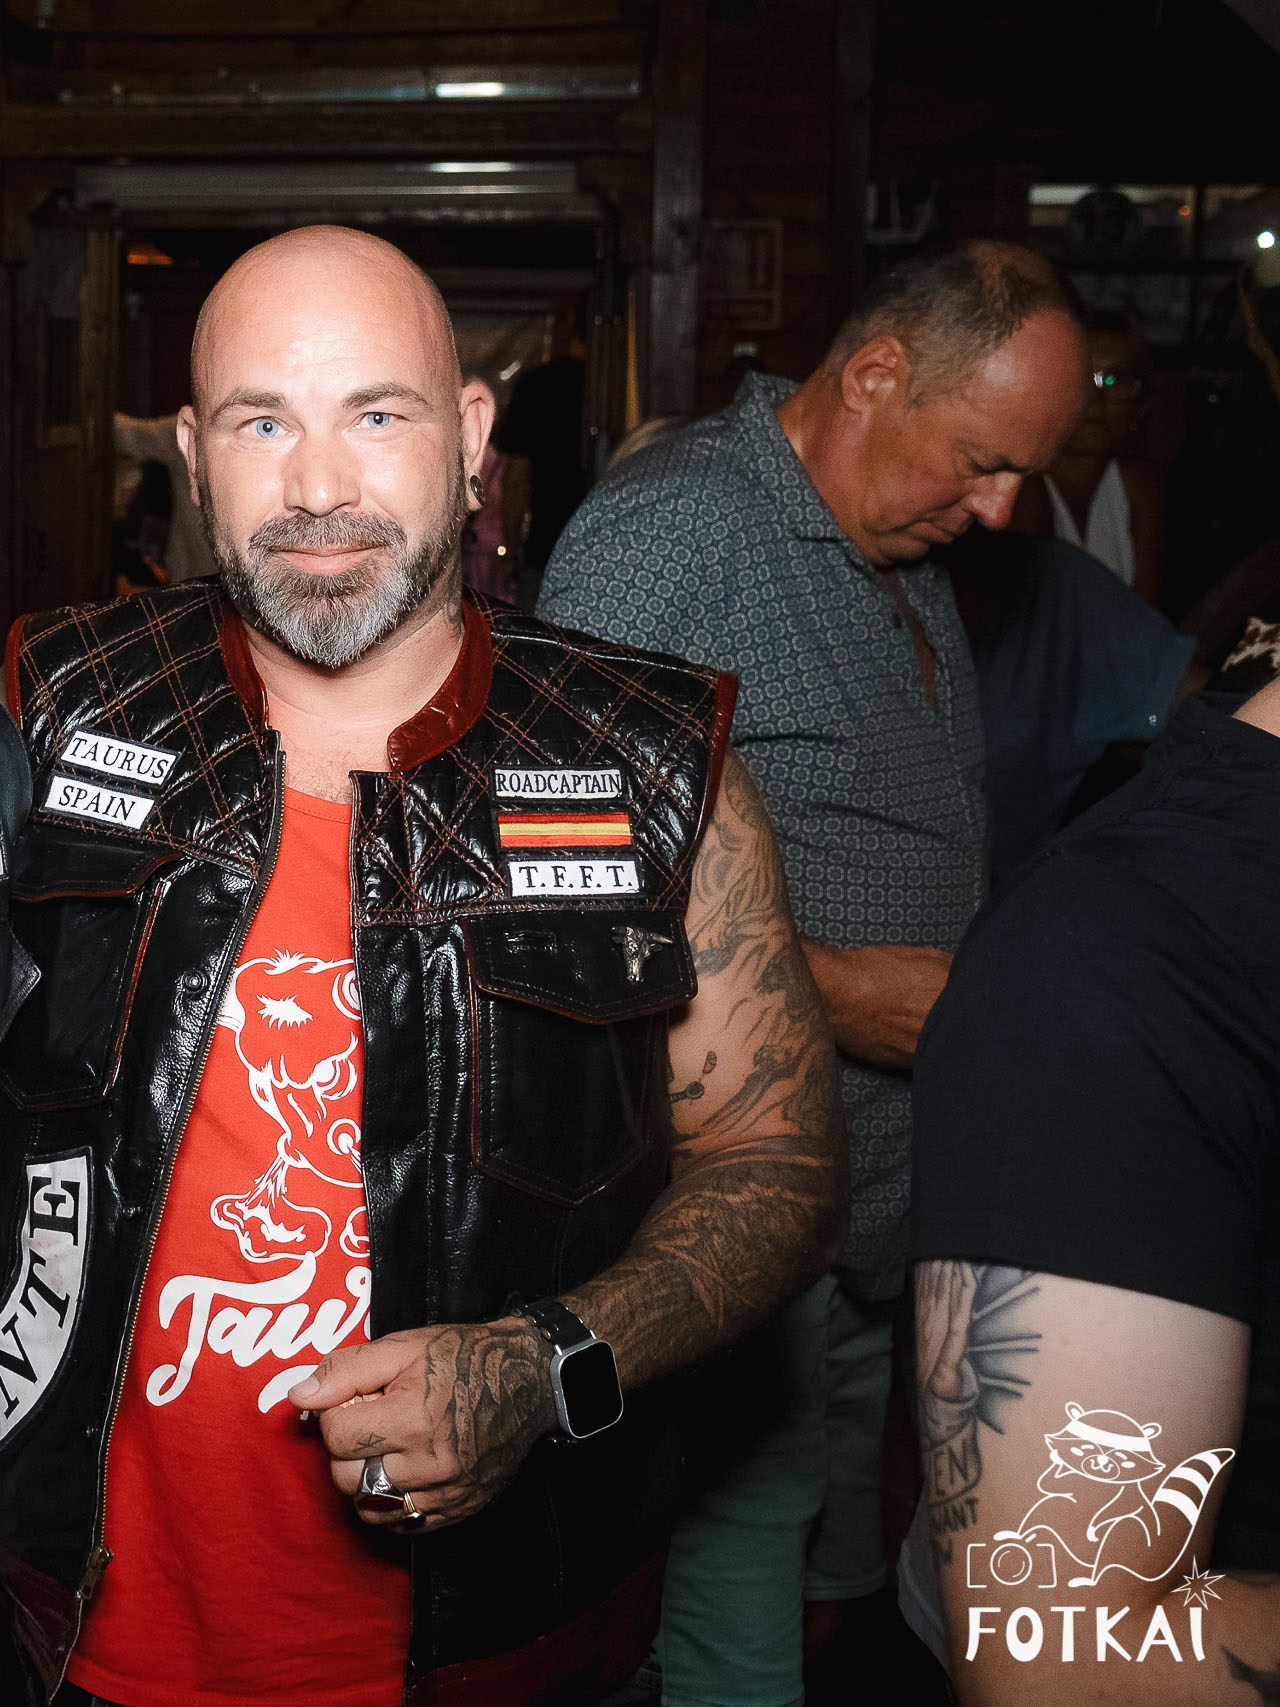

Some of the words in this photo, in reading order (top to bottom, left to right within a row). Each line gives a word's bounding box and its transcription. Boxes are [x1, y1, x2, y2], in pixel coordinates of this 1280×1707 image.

[69, 737, 169, 778] TAURUS
[496, 773, 620, 794] ROADCAPTAIN
[58, 785, 136, 821] SPAIN
[519, 866, 633, 888] T.F.F.T.
[146, 1250, 372, 1407] Taur
